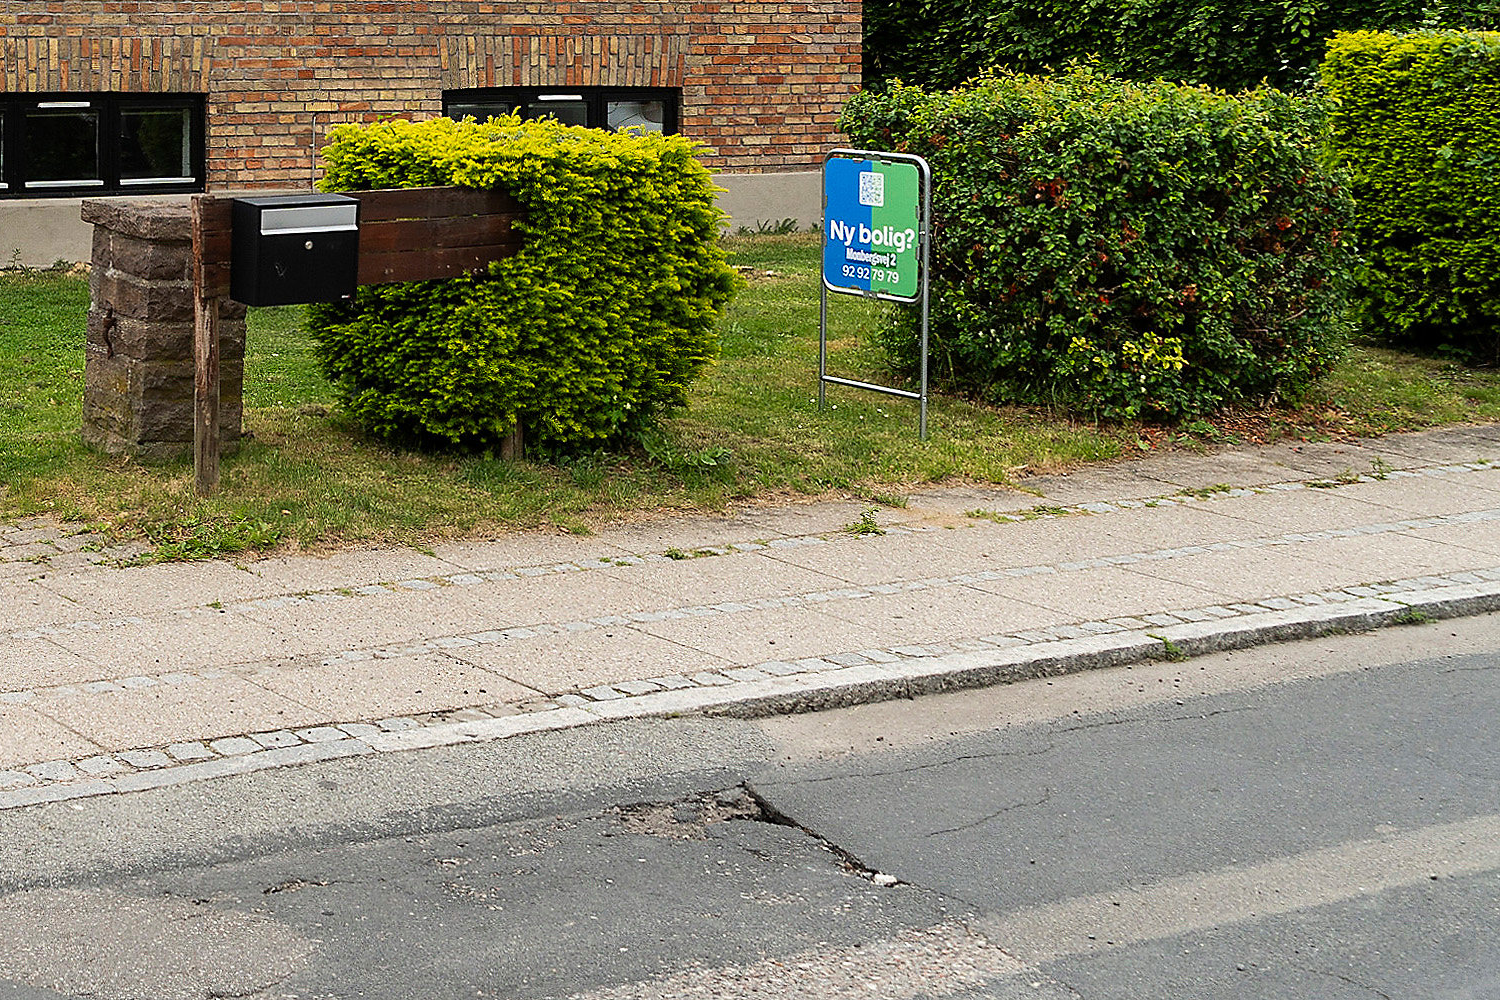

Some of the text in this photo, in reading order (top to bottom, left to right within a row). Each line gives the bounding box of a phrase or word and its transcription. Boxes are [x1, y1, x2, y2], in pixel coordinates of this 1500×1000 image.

[830, 219, 915, 253] Ny bolig?
[890, 253, 897, 266] 2
[842, 264, 899, 284] 92 92 79 79
